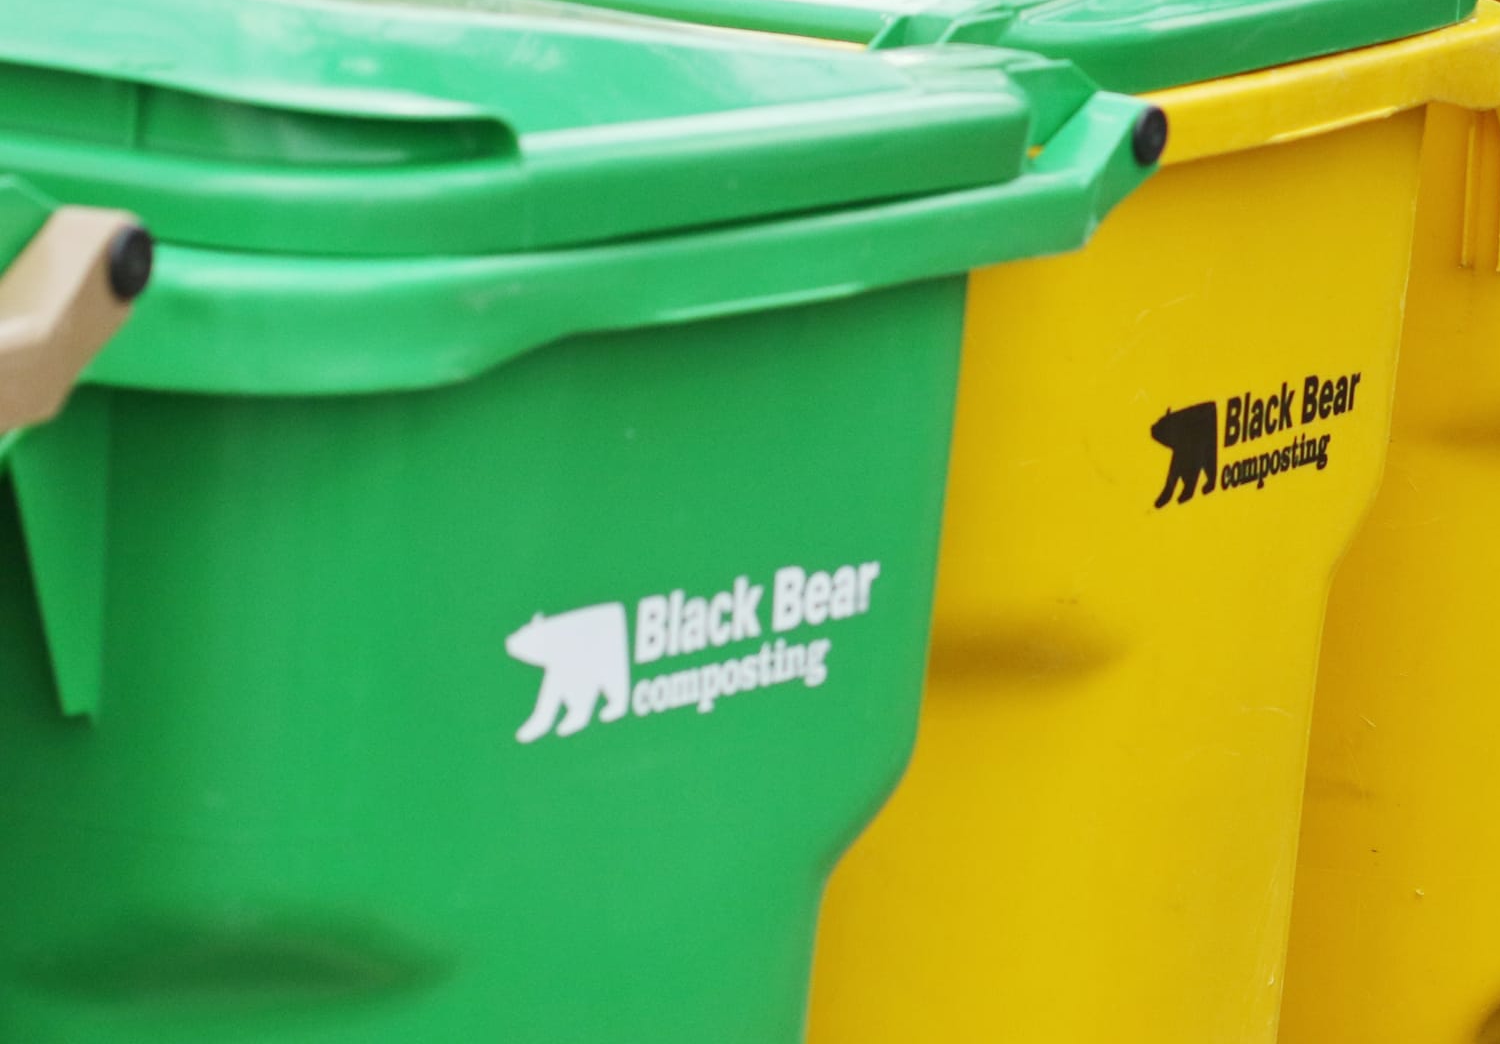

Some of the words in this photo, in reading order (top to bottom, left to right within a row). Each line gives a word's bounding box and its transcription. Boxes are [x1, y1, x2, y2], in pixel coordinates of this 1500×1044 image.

[1223, 381, 1296, 448] Black
[1301, 371, 1362, 425] Bear
[1220, 432, 1331, 491] composting
[634, 574, 765, 665] Black
[771, 560, 882, 633] Bear
[631, 637, 832, 717] composting
